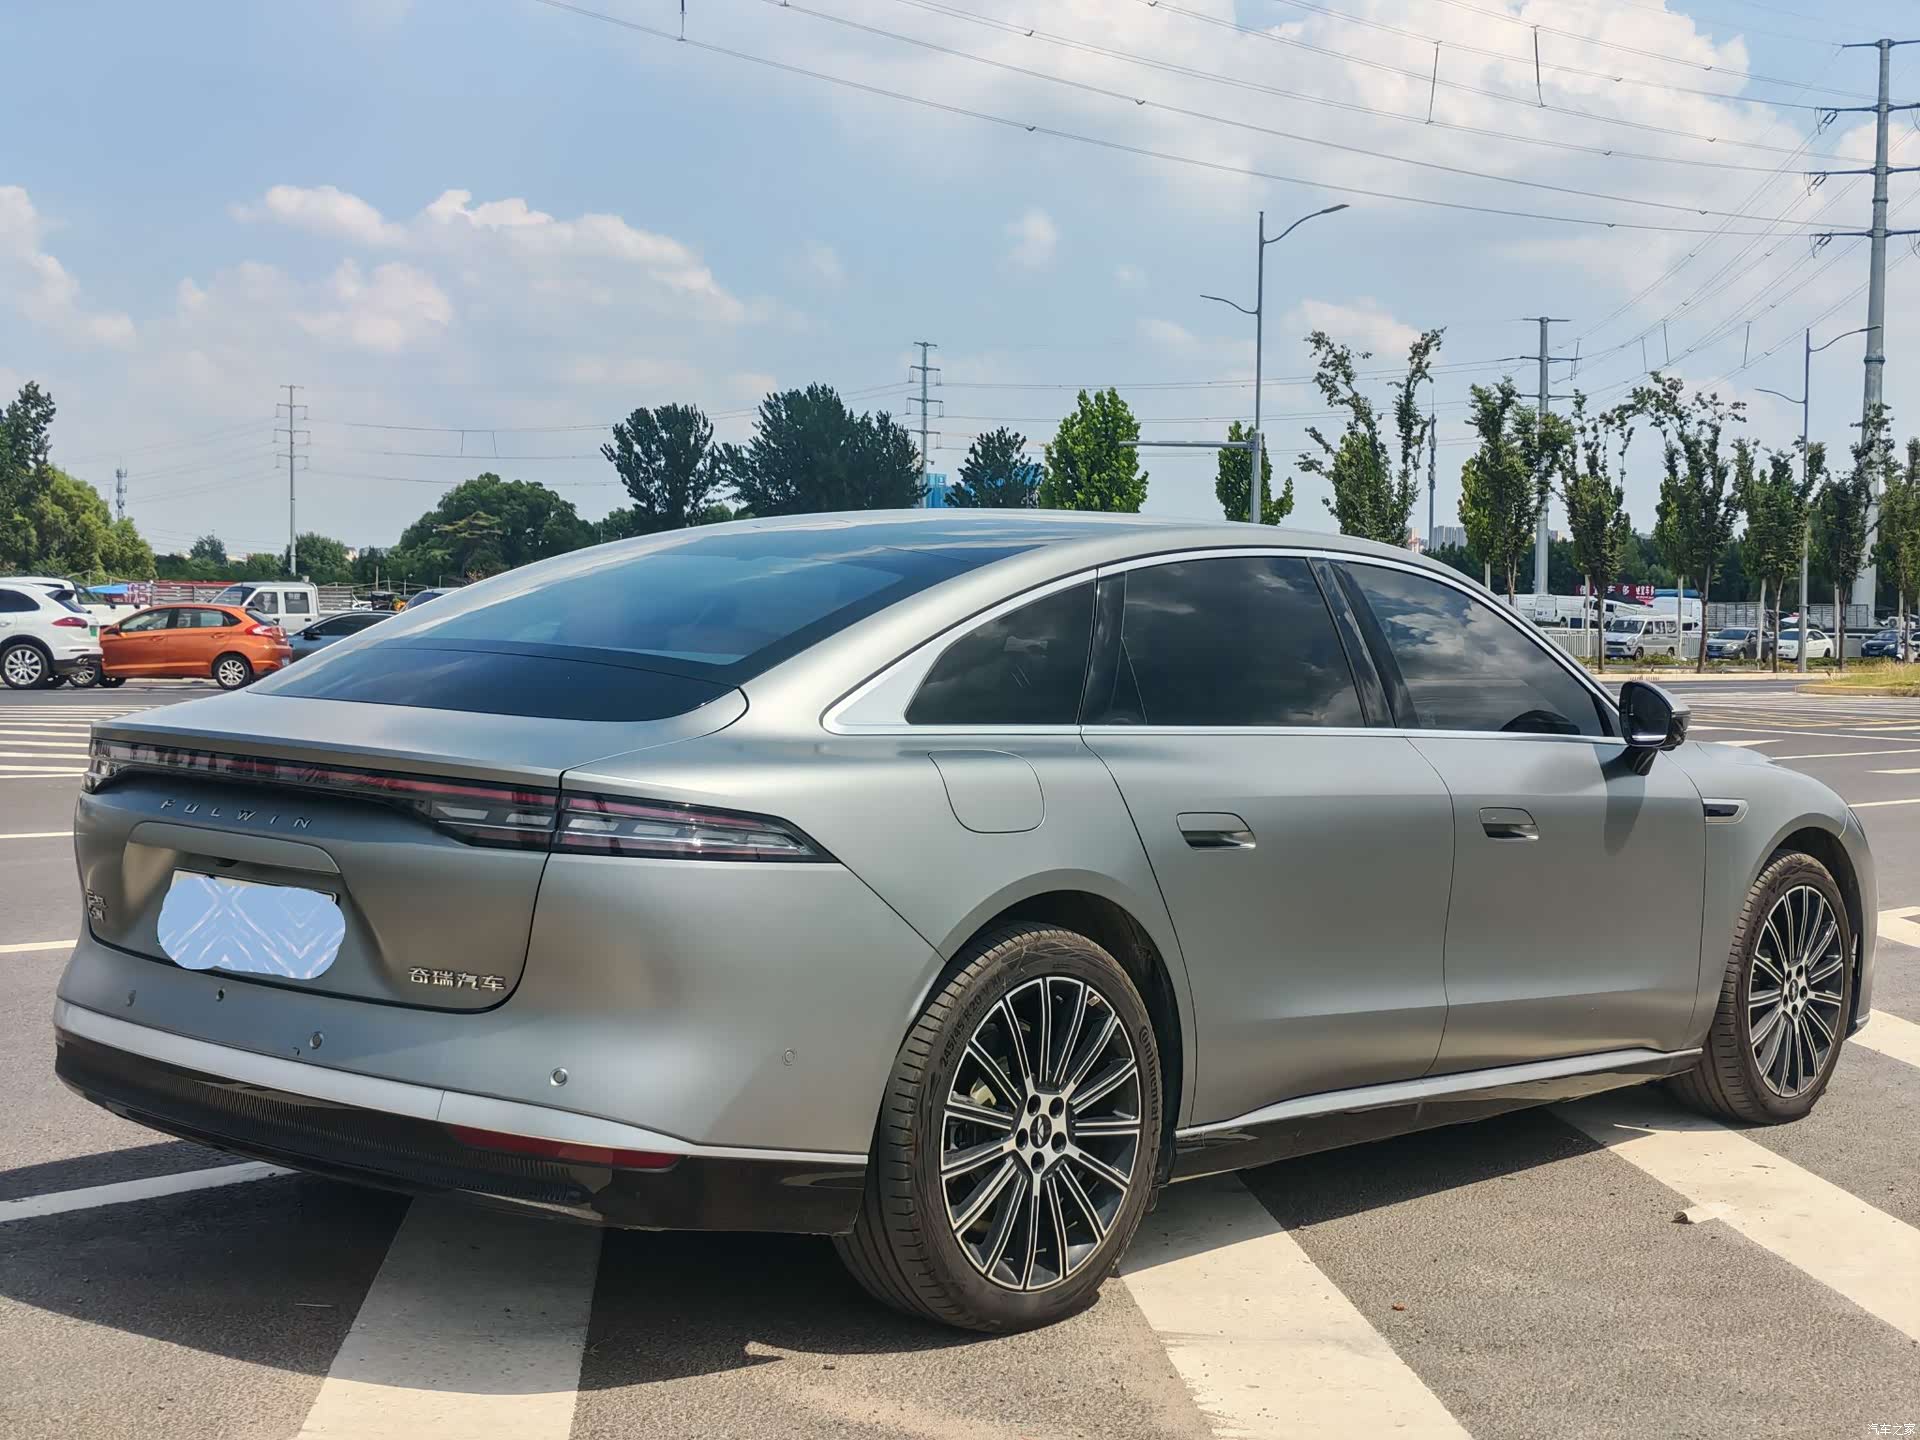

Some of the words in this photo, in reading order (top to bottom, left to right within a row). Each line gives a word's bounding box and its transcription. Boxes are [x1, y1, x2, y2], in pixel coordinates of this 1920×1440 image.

[160, 799, 313, 829] FULWIN
[408, 967, 505, 992] 奇瑞汽车
